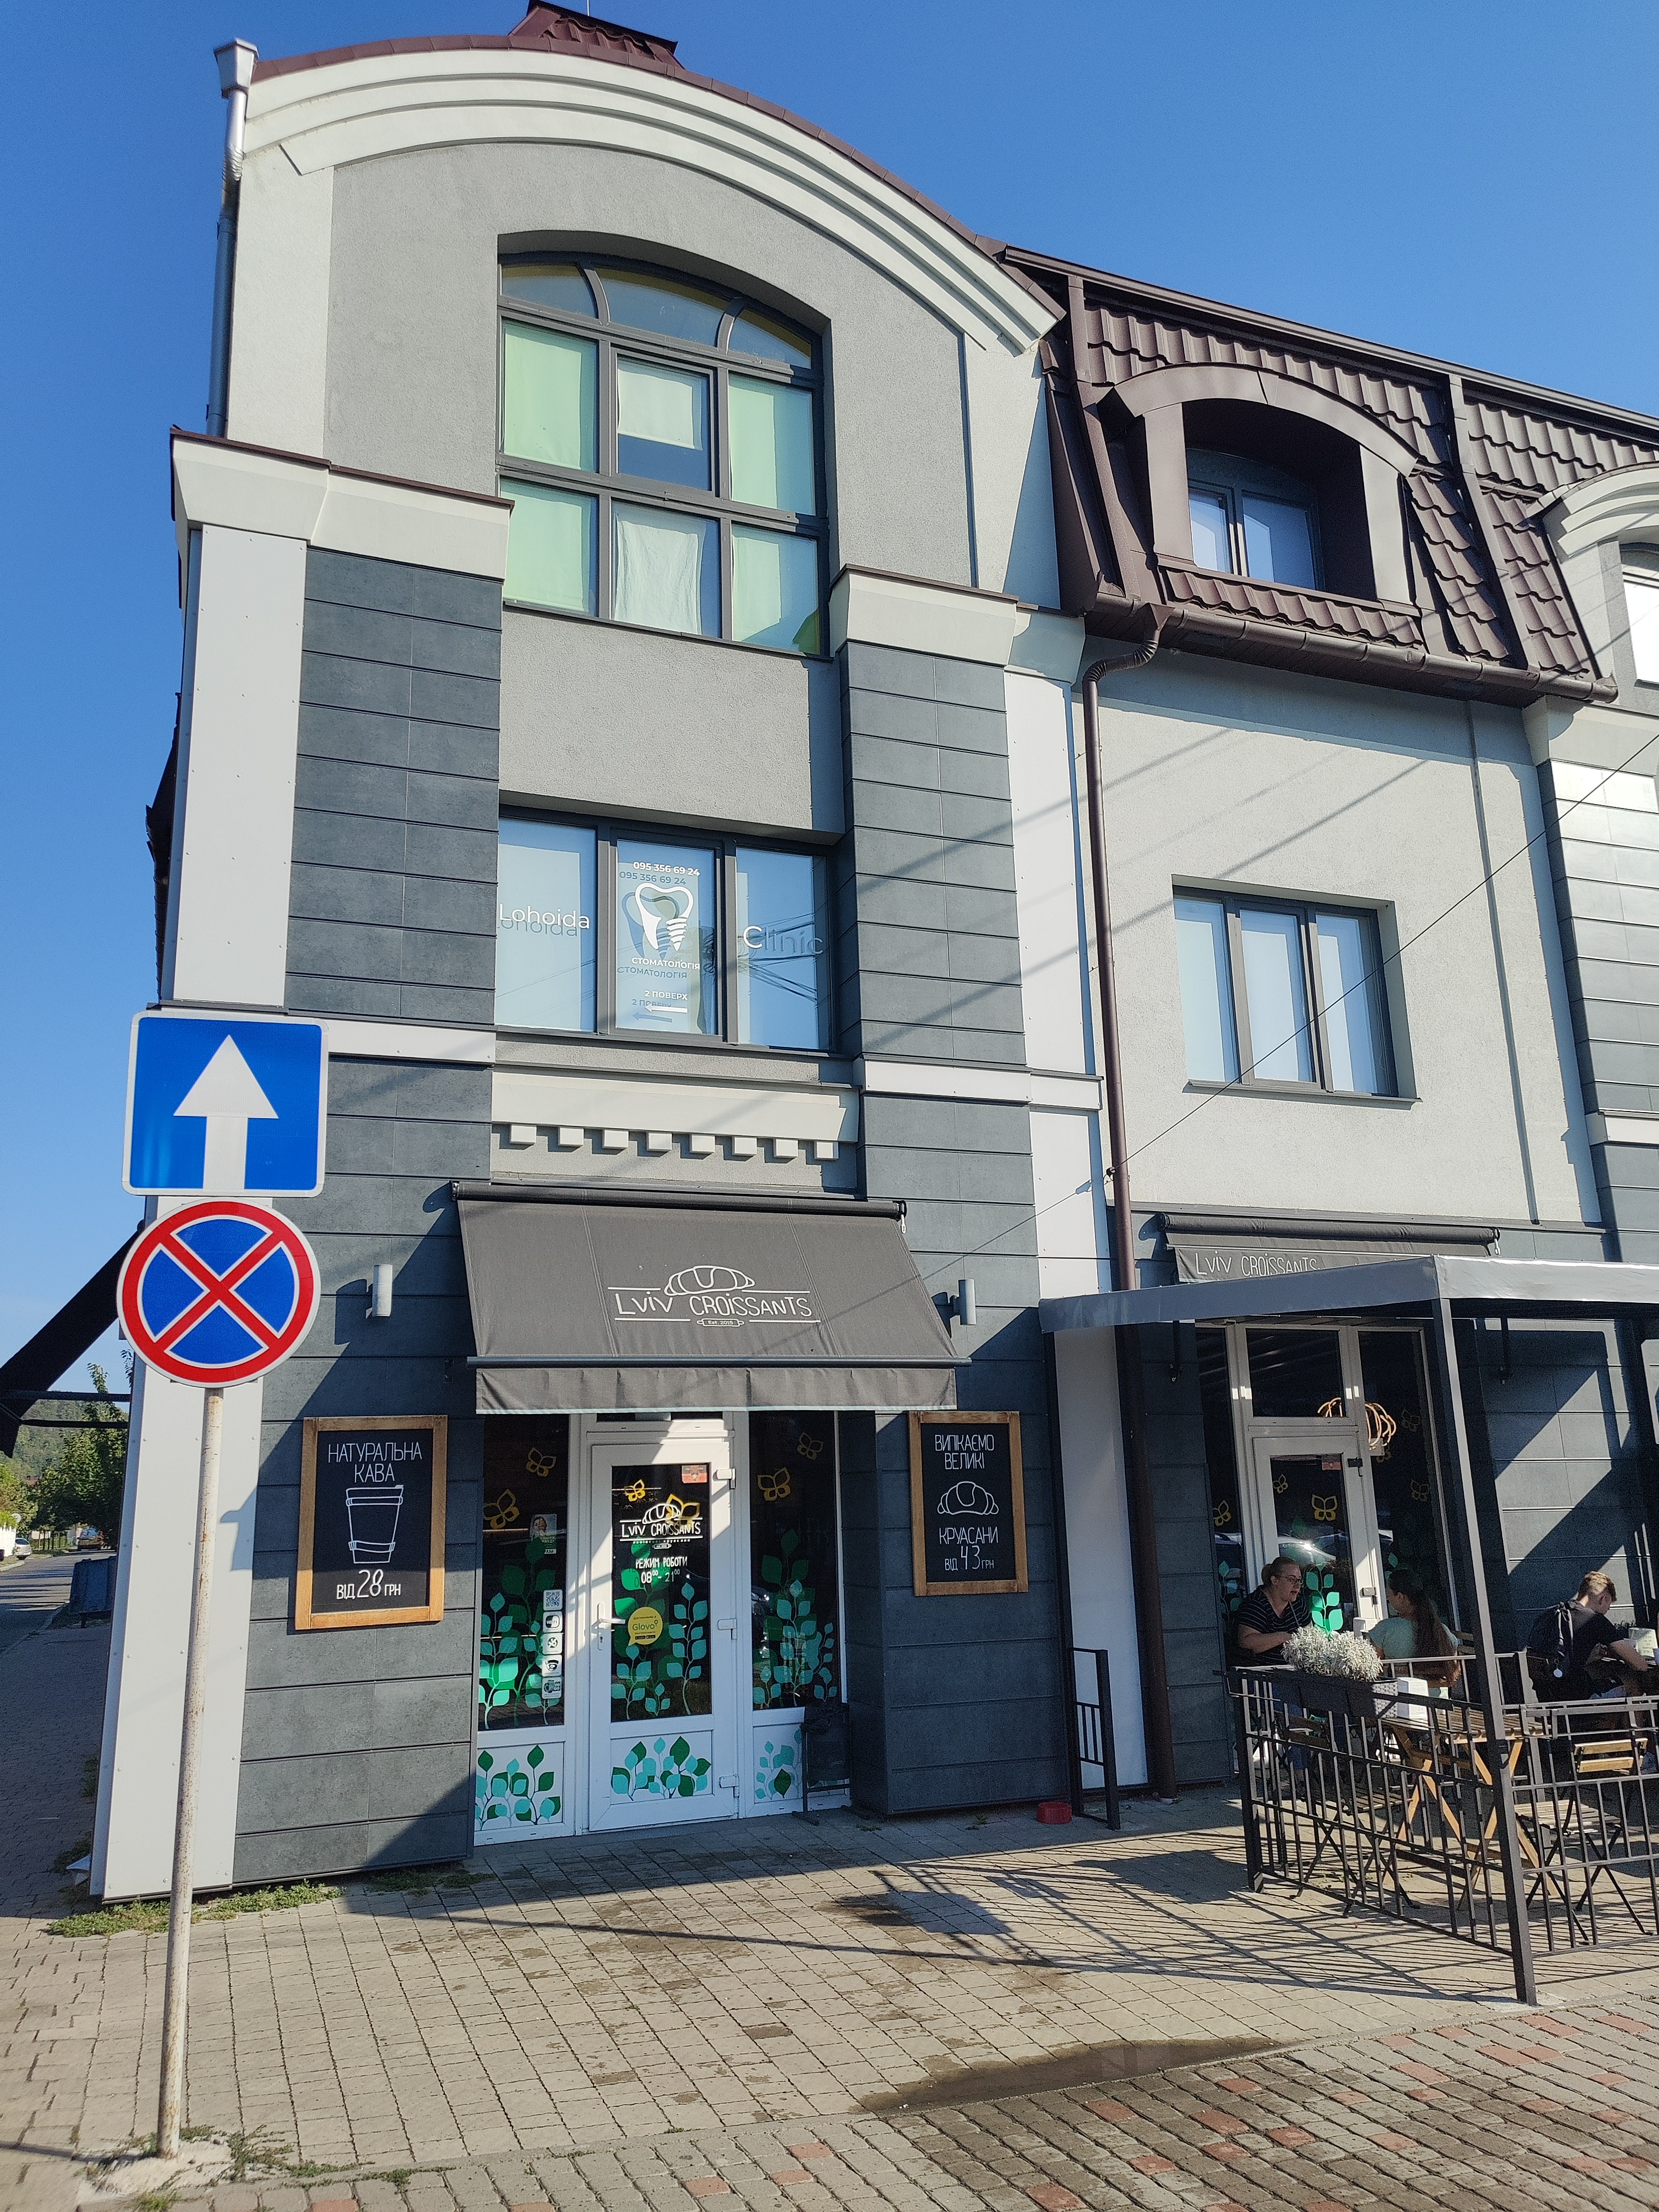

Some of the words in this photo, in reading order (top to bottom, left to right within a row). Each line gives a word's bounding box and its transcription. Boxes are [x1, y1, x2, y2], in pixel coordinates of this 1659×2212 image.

[633, 862, 651, 870] 095
[654, 864, 671, 873] 356
[674, 866, 685, 874] 69
[687, 868, 700, 877] 24
[499, 904, 589, 929] Lohoida
[632, 957, 700, 969] СТОМАТОЛОГІЯ
[652, 991, 687, 1000] ПОВЕРХ
[935, 1434, 994, 1452] ВИПІКАЄМО
[328, 1442, 422, 1463] НАТУРАЛЬНА
[945, 1452, 984, 1469] ВЕЛИКІ
[354, 1463, 395, 1483] КАВА
[939, 1527, 998, 1544] КРУАСАНИ
[636, 1558, 660, 1569] РЕЖИМ
[663, 1556, 688, 1568] РОБОТИ
[945, 1558, 958, 1572] ВІД
[960, 1546, 980, 1570] 43
[982, 1559, 994, 1570] ГРН
[336, 1584, 355, 1600] ВІД
[357, 1568, 384, 1598] 28
[384, 1583, 401, 1597] ГРН
